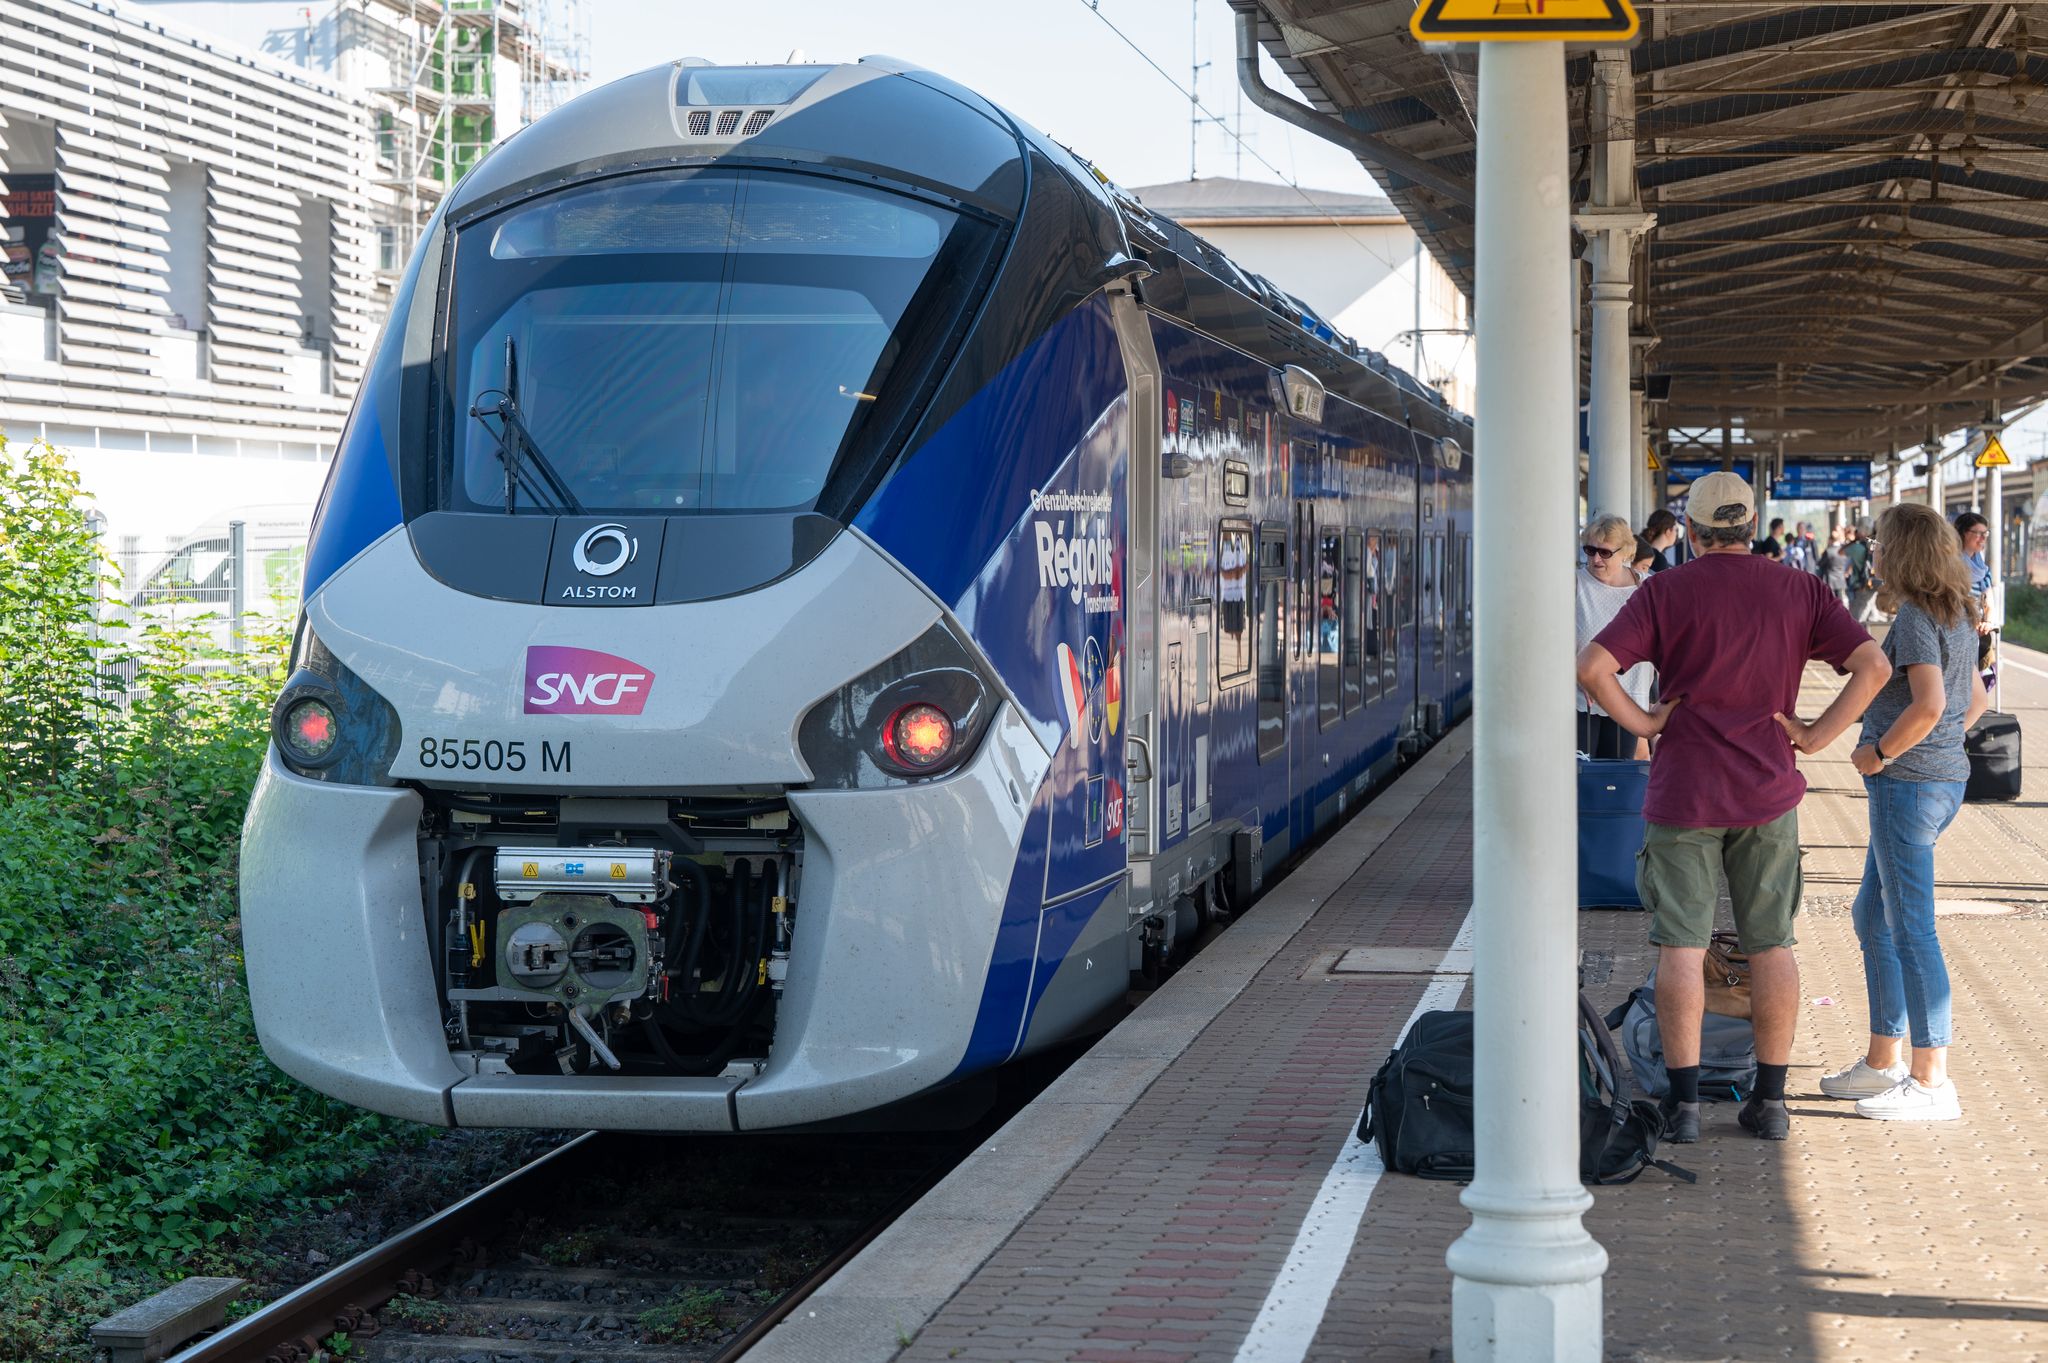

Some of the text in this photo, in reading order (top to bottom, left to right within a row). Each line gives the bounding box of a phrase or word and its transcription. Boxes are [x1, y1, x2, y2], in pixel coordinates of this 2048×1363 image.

[1030, 489, 1112, 513] Grenzüberschreitender
[1034, 518, 1113, 605] Régiolis
[562, 585, 637, 600] ALSTOM
[529, 673, 645, 706] SNCF
[419, 736, 572, 773] 85505 M
